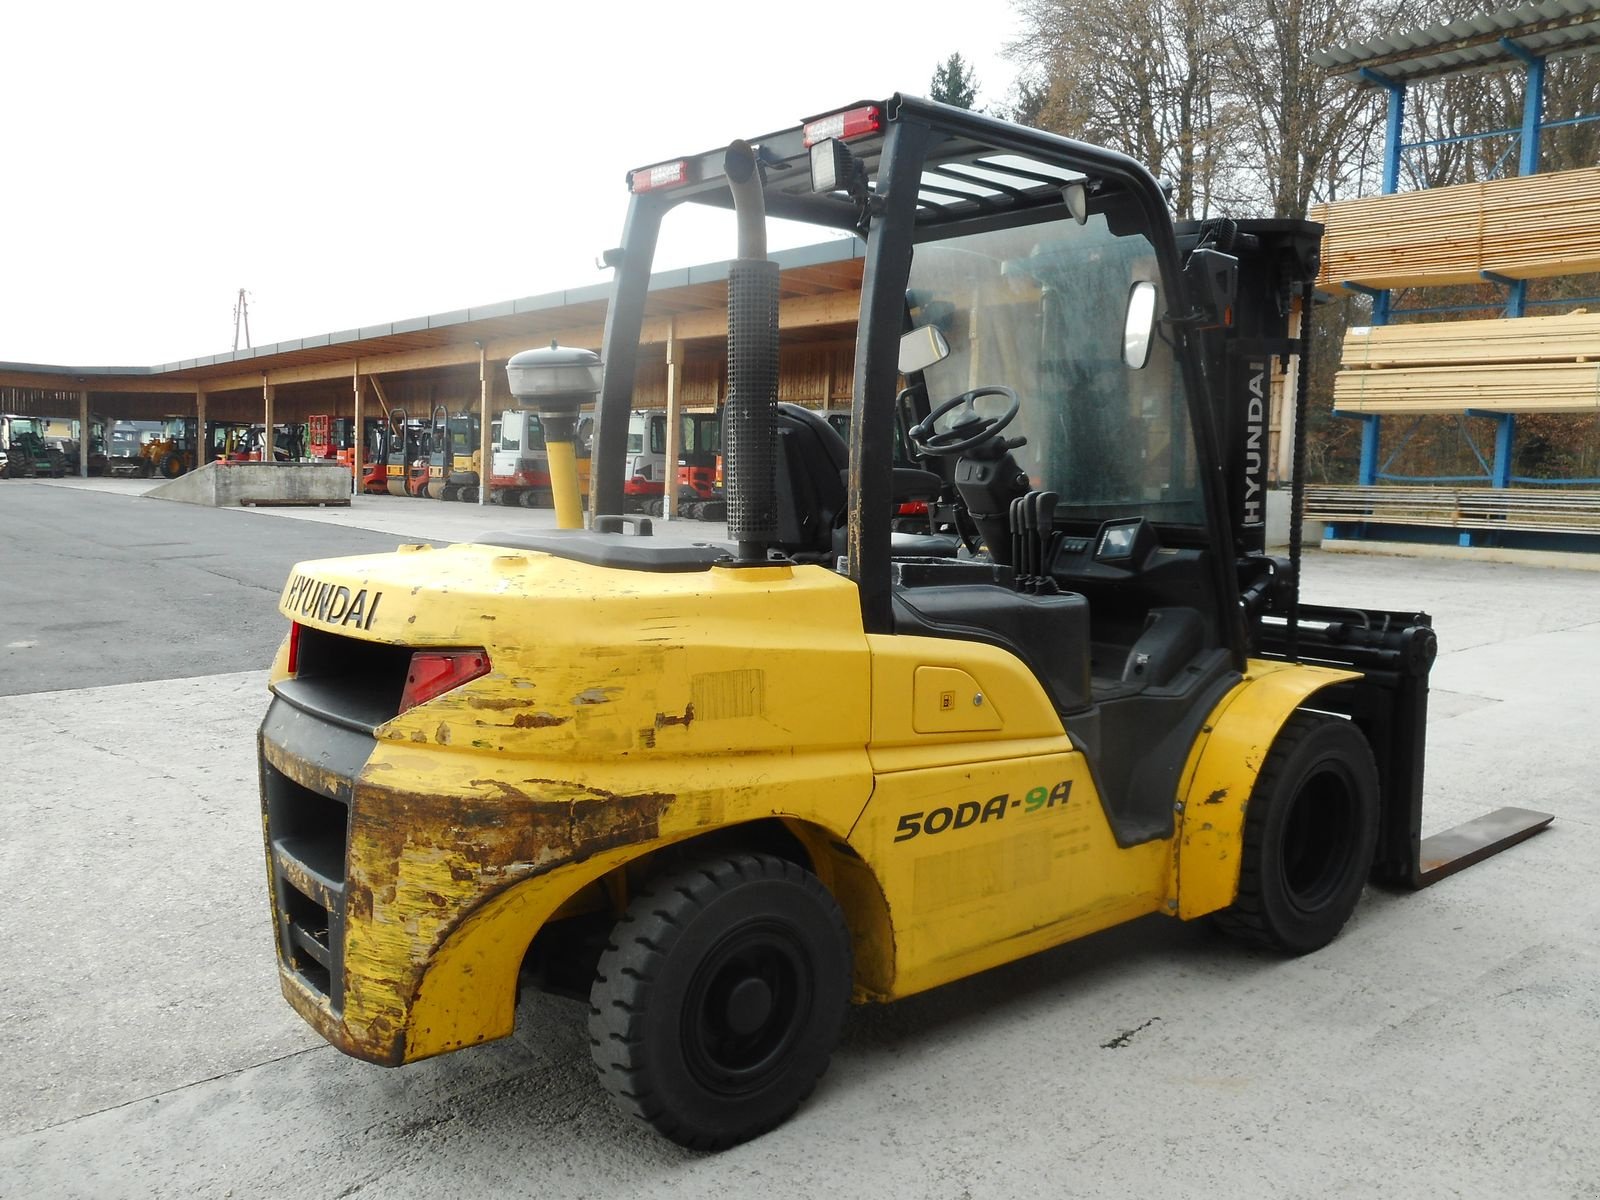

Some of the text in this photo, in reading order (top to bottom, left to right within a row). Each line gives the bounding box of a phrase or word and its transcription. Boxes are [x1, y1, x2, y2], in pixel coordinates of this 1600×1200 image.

[1244, 362, 1264, 523] HYUNDAI
[285, 575, 382, 630] HYUNDAI
[894, 781, 1073, 843] 50DA-9A
